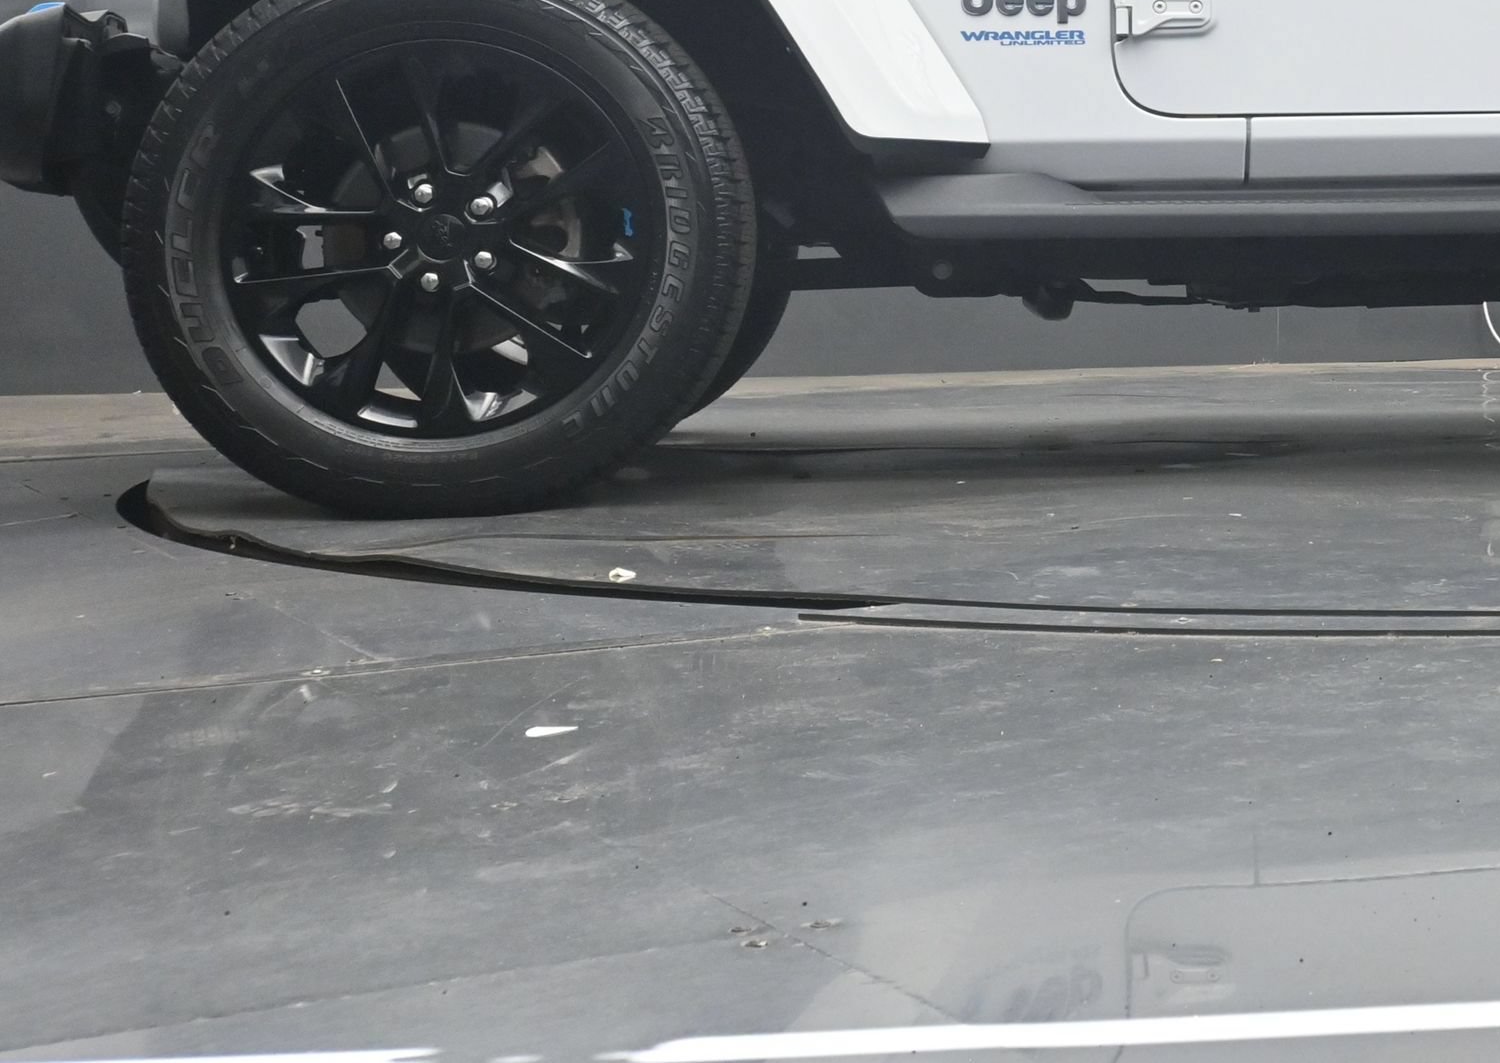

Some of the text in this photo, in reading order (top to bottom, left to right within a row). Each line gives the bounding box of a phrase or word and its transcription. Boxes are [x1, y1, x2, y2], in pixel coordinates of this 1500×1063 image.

[960, 30, 1085, 42] WRANGLER
[1000, 39, 1086, 47] UNLIMITED
[170, 120, 244, 386] DUELER
